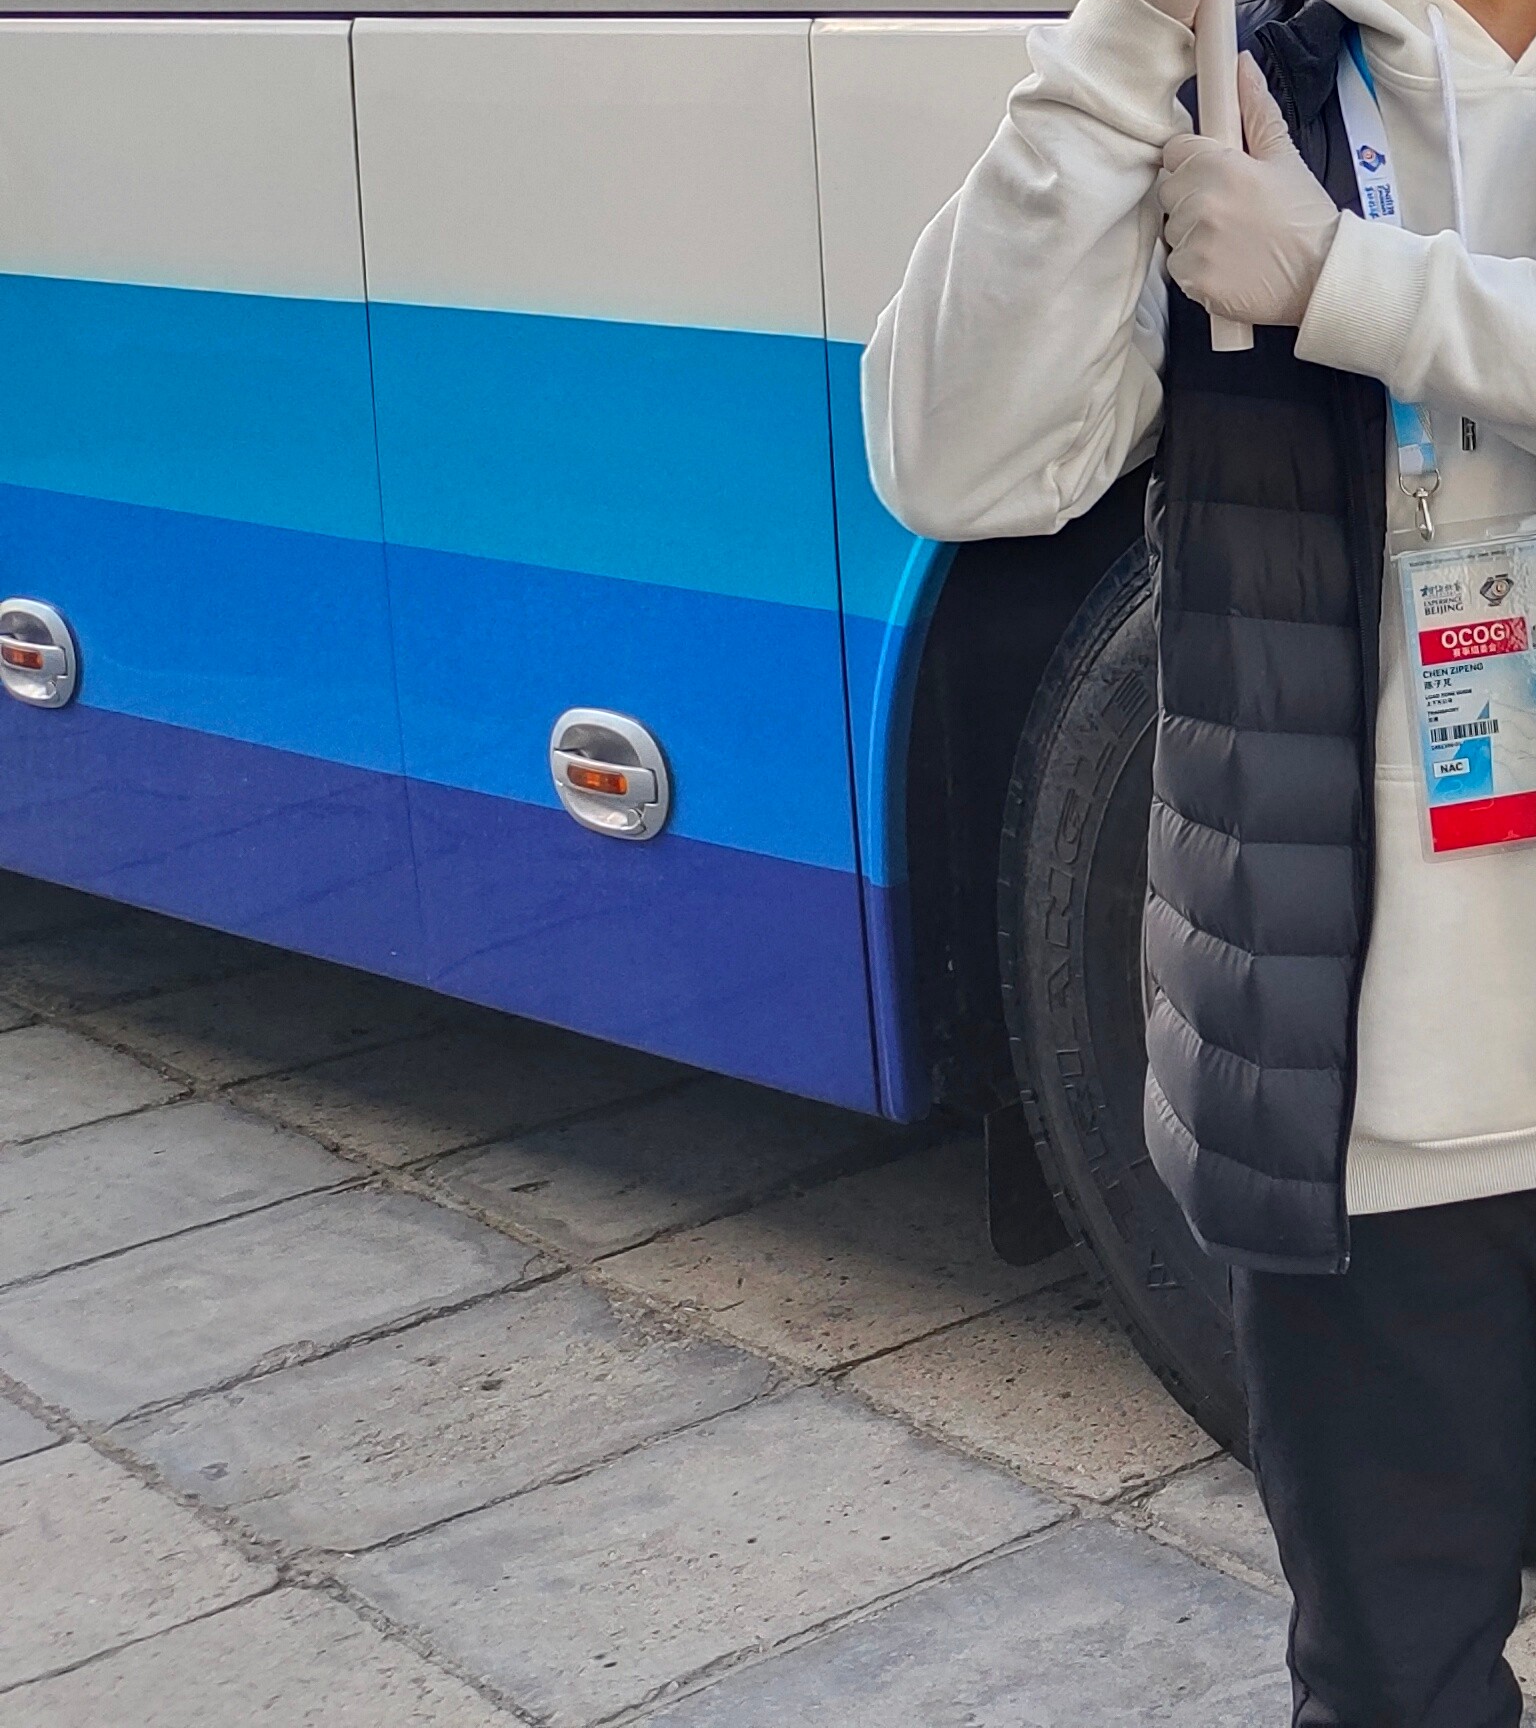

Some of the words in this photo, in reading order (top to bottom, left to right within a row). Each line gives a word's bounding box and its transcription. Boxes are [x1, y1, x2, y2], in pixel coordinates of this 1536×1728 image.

[1424, 603, 1464, 616] BEIJING
[1441, 623, 1506, 649] OCOG
[1422, 668, 1448, 679] CHEN
[1450, 663, 1484, 675] ZIPENG
[1440, 762, 1464, 773] NAC
